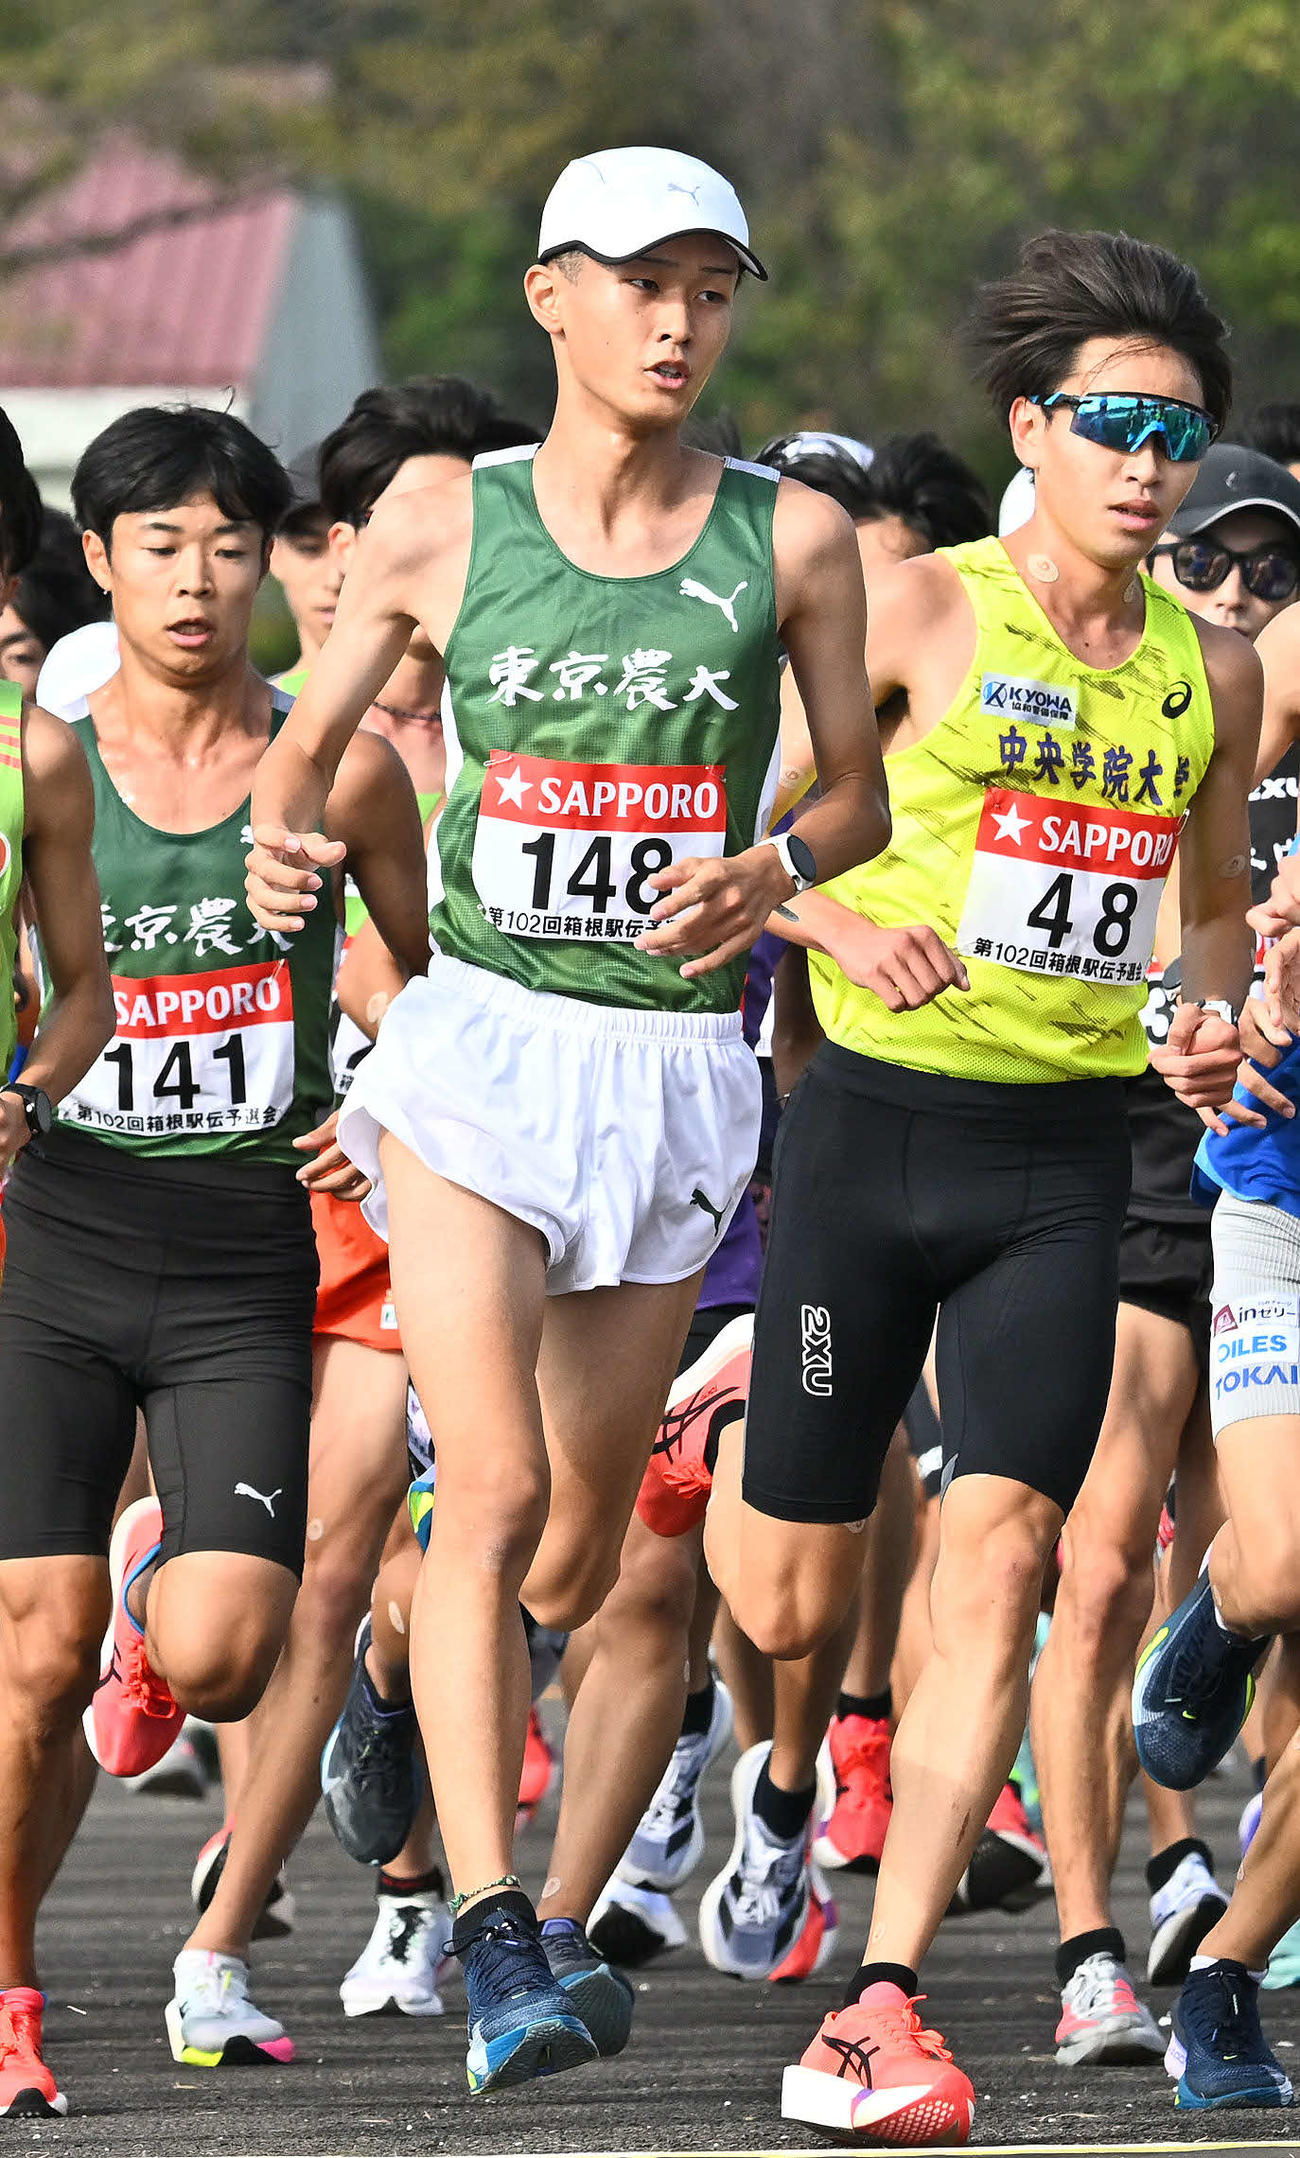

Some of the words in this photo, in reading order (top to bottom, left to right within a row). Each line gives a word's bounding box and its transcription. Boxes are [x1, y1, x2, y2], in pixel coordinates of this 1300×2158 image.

[485, 645, 739, 711] 東京農大
[1009, 686, 1072, 712] KYOWA
[536, 776, 719, 820] SAPPORO
[521, 832, 674, 915] 148
[1026, 872, 1138, 958] 48
[113, 977, 281, 1027] SAPPORO
[104, 1033, 247, 1111] 141
[801, 1304, 832, 1397] 2XU
[1218, 1334, 1288, 1363] OILES
